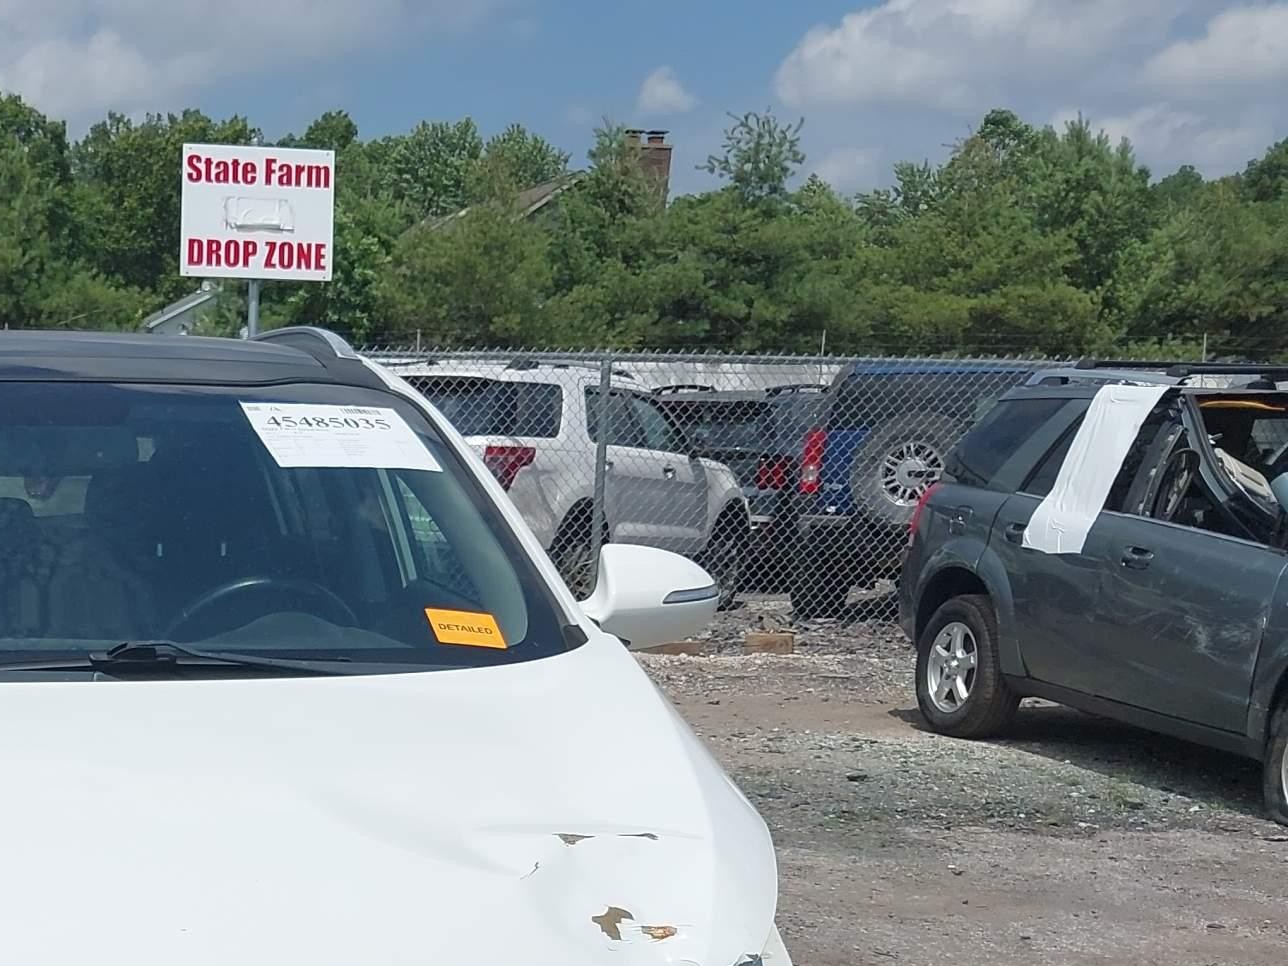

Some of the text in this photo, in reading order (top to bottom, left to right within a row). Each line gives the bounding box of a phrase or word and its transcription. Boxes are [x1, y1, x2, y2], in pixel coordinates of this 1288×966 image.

[187, 154, 330, 188] State Farm
[187, 238, 326, 270] DROP ZONE
[266, 415, 391, 430] 45485035
[438, 623, 493, 635] DETAILED
